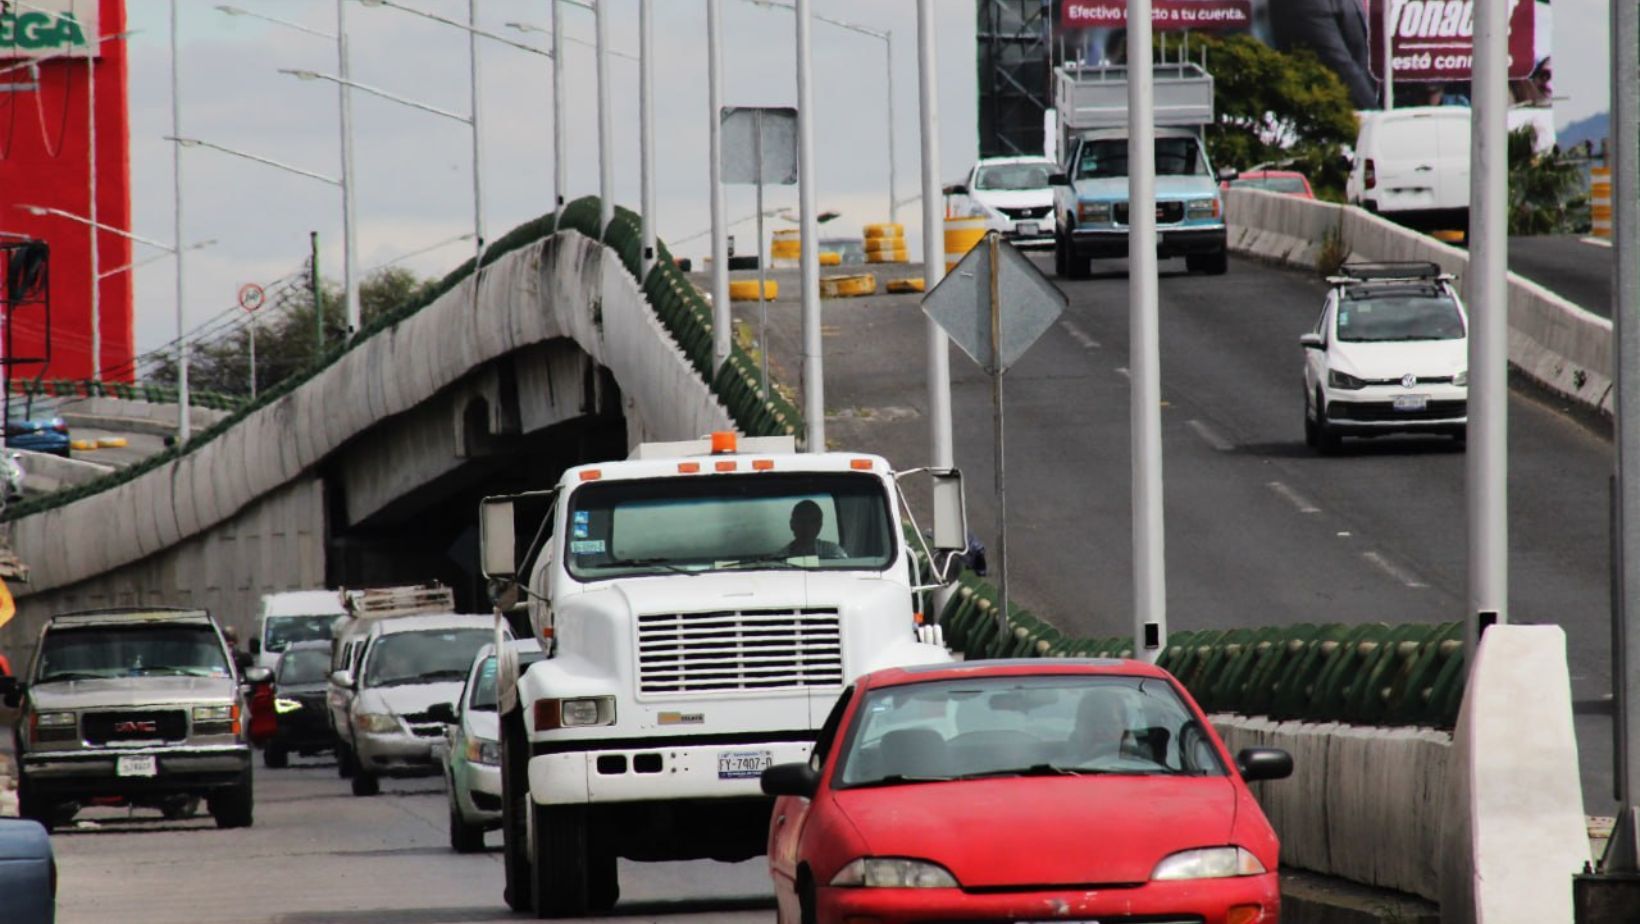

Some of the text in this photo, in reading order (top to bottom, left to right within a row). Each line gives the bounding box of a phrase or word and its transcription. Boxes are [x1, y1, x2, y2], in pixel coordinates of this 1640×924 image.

[1069, 5, 1121, 19] Efectivo
[1171, 9, 1179, 20] a
[1181, 8, 1196, 20] tu
[1197, 8, 1247, 20] cuenta.
[1393, 52, 1431, 70] está
